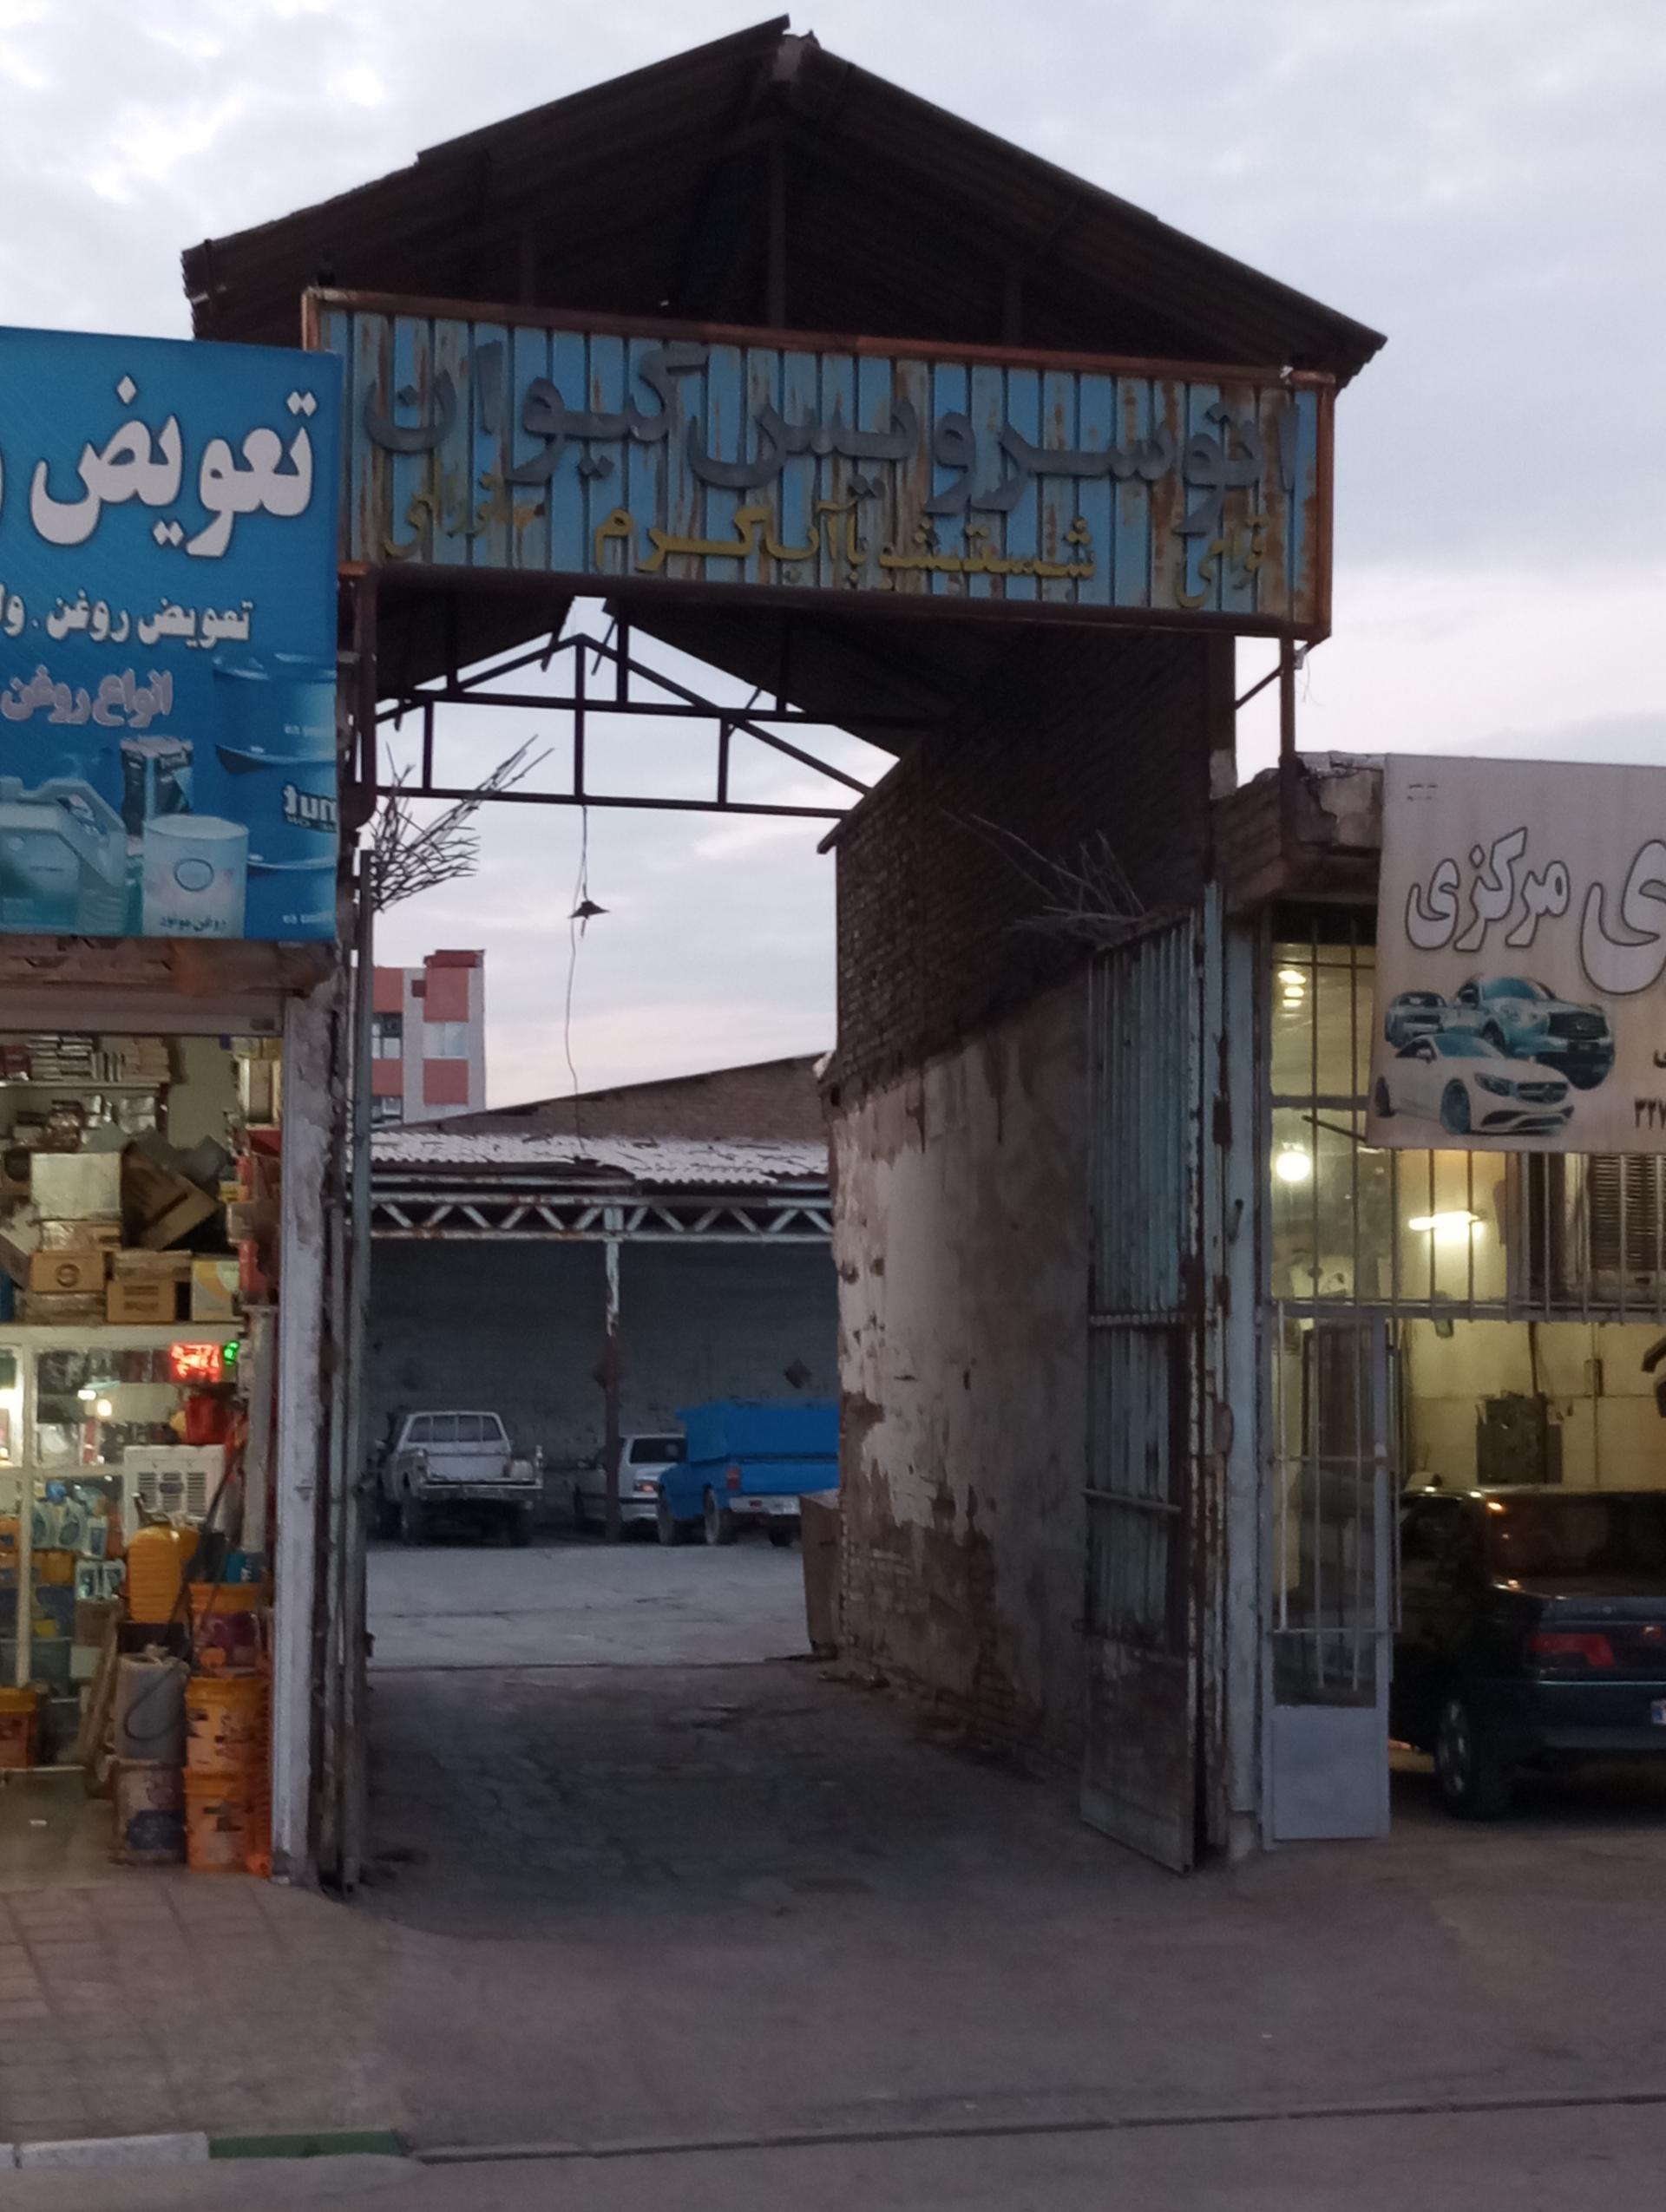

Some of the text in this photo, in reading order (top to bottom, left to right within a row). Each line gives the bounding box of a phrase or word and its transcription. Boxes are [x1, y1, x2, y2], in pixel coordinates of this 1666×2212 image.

[363, 338, 712, 486] کیوان
[30, 373, 318, 558] تعویض
[45, 587, 130, 643] روغن
[136, 596, 255, 650] تعویض
[1, 663, 174, 730] انواع روغن
[1404, 825, 1571, 952] مرکزی
